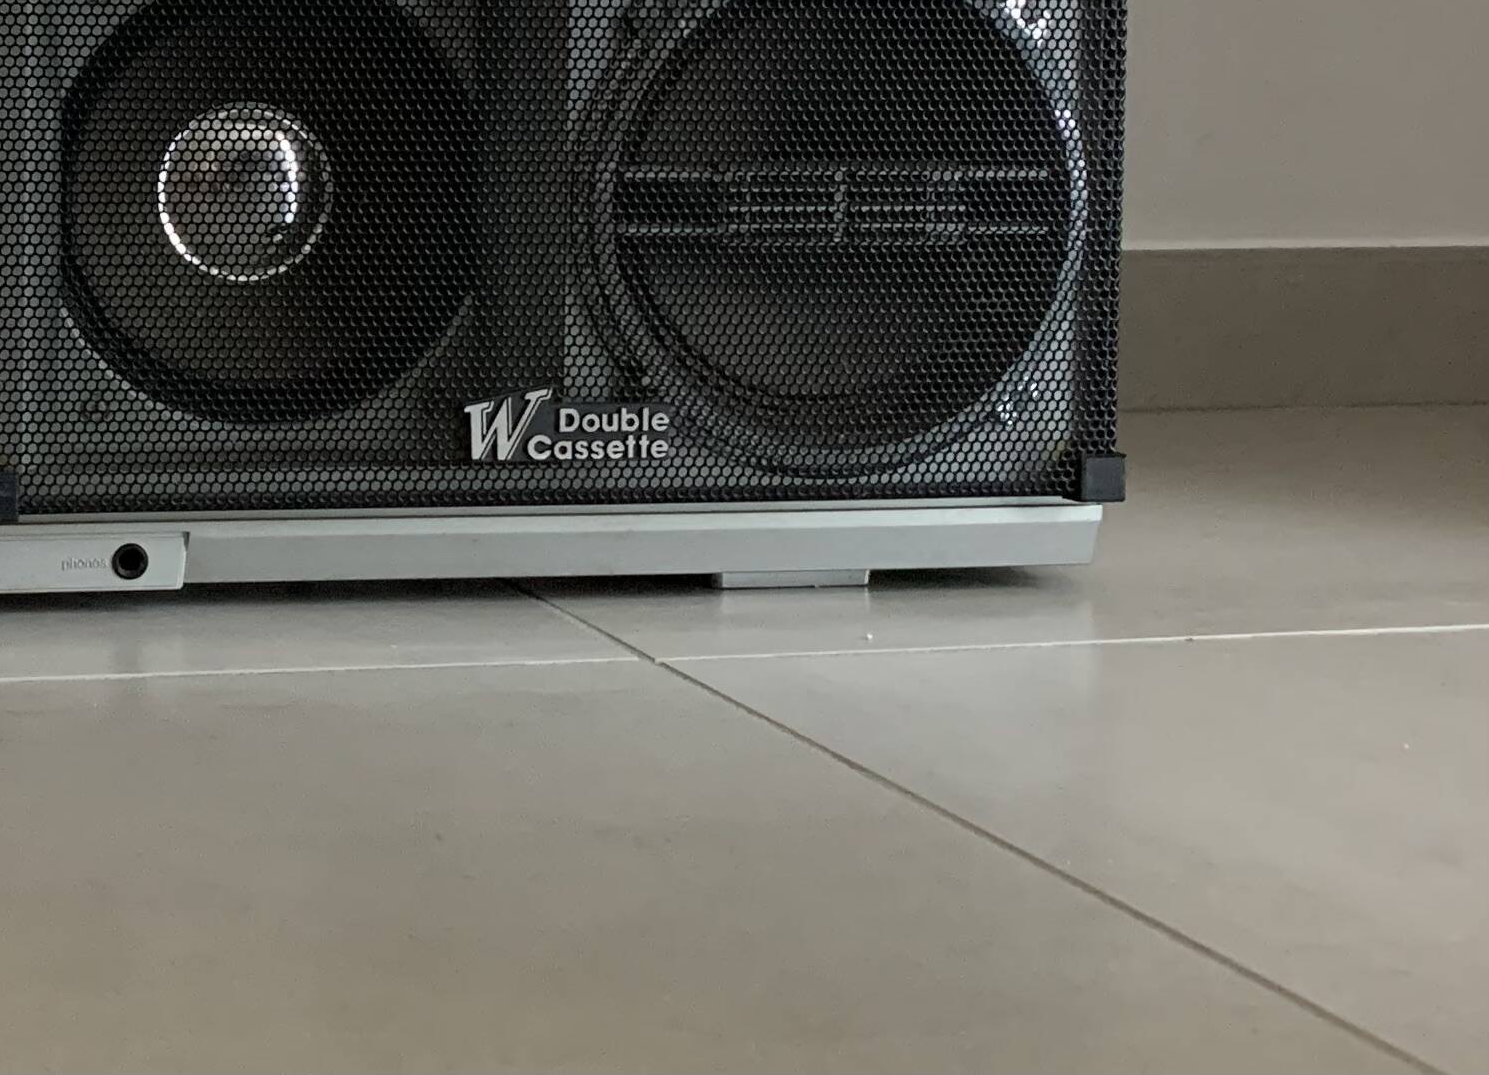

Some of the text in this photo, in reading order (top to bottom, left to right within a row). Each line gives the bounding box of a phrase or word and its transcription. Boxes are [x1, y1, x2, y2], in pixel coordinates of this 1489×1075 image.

[463, 386, 670, 461] W Double
[527, 433, 669, 461] Cassette
